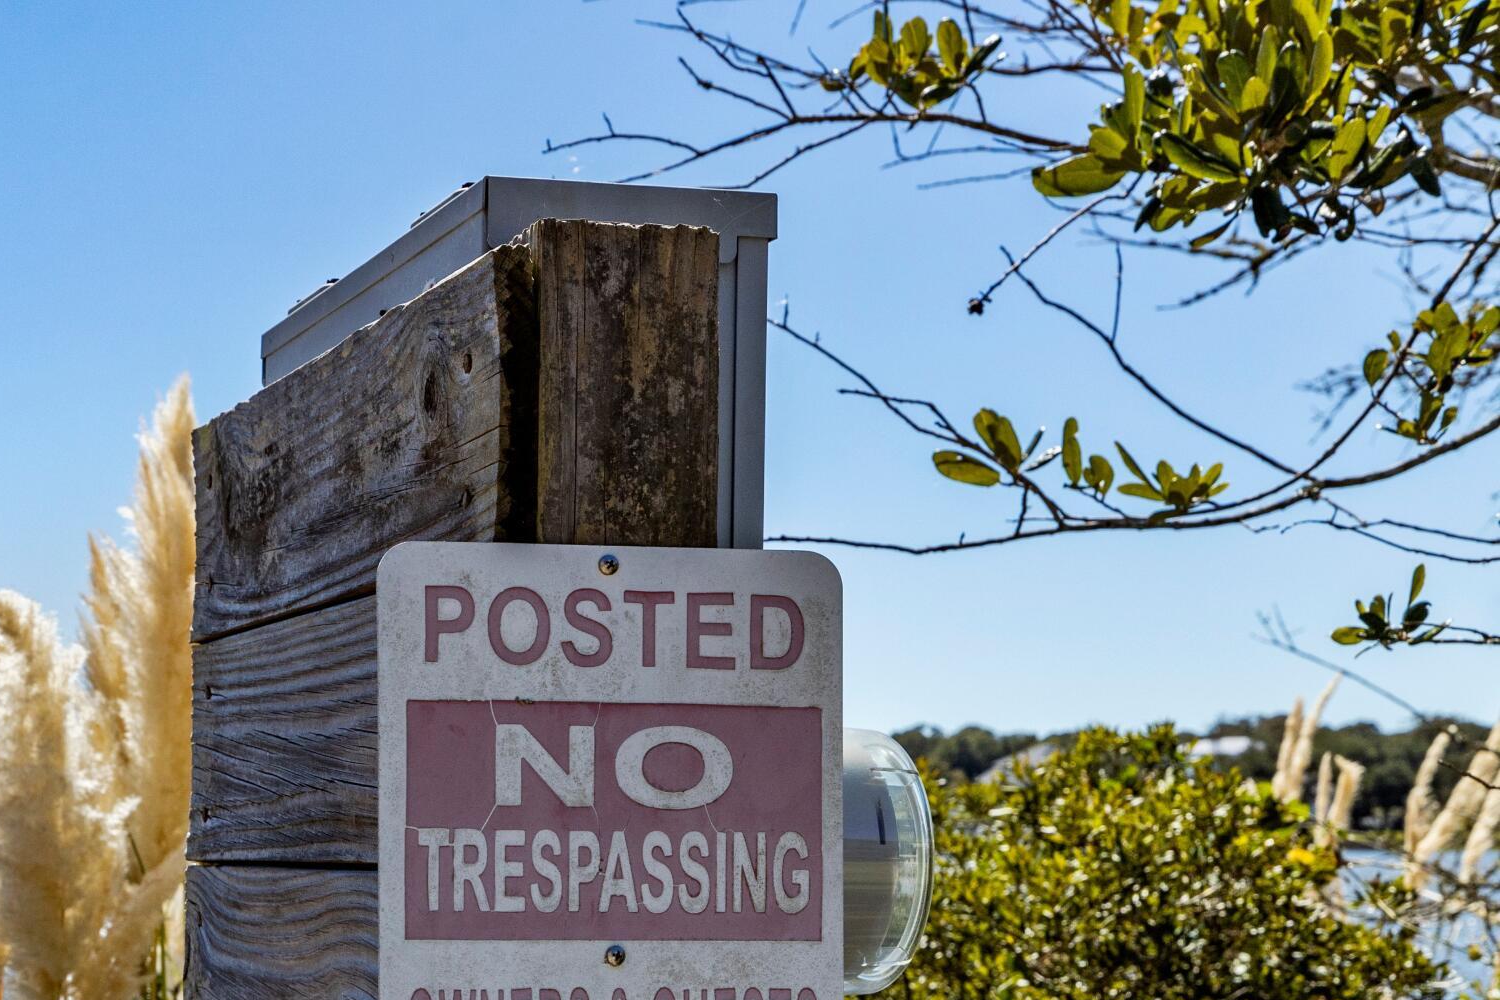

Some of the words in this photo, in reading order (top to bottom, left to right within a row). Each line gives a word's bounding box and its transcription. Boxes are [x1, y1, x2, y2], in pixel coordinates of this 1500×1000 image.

[424, 585, 806, 671] POSTED
[495, 724, 734, 810] NO
[418, 829, 810, 914] TRESPASSING
